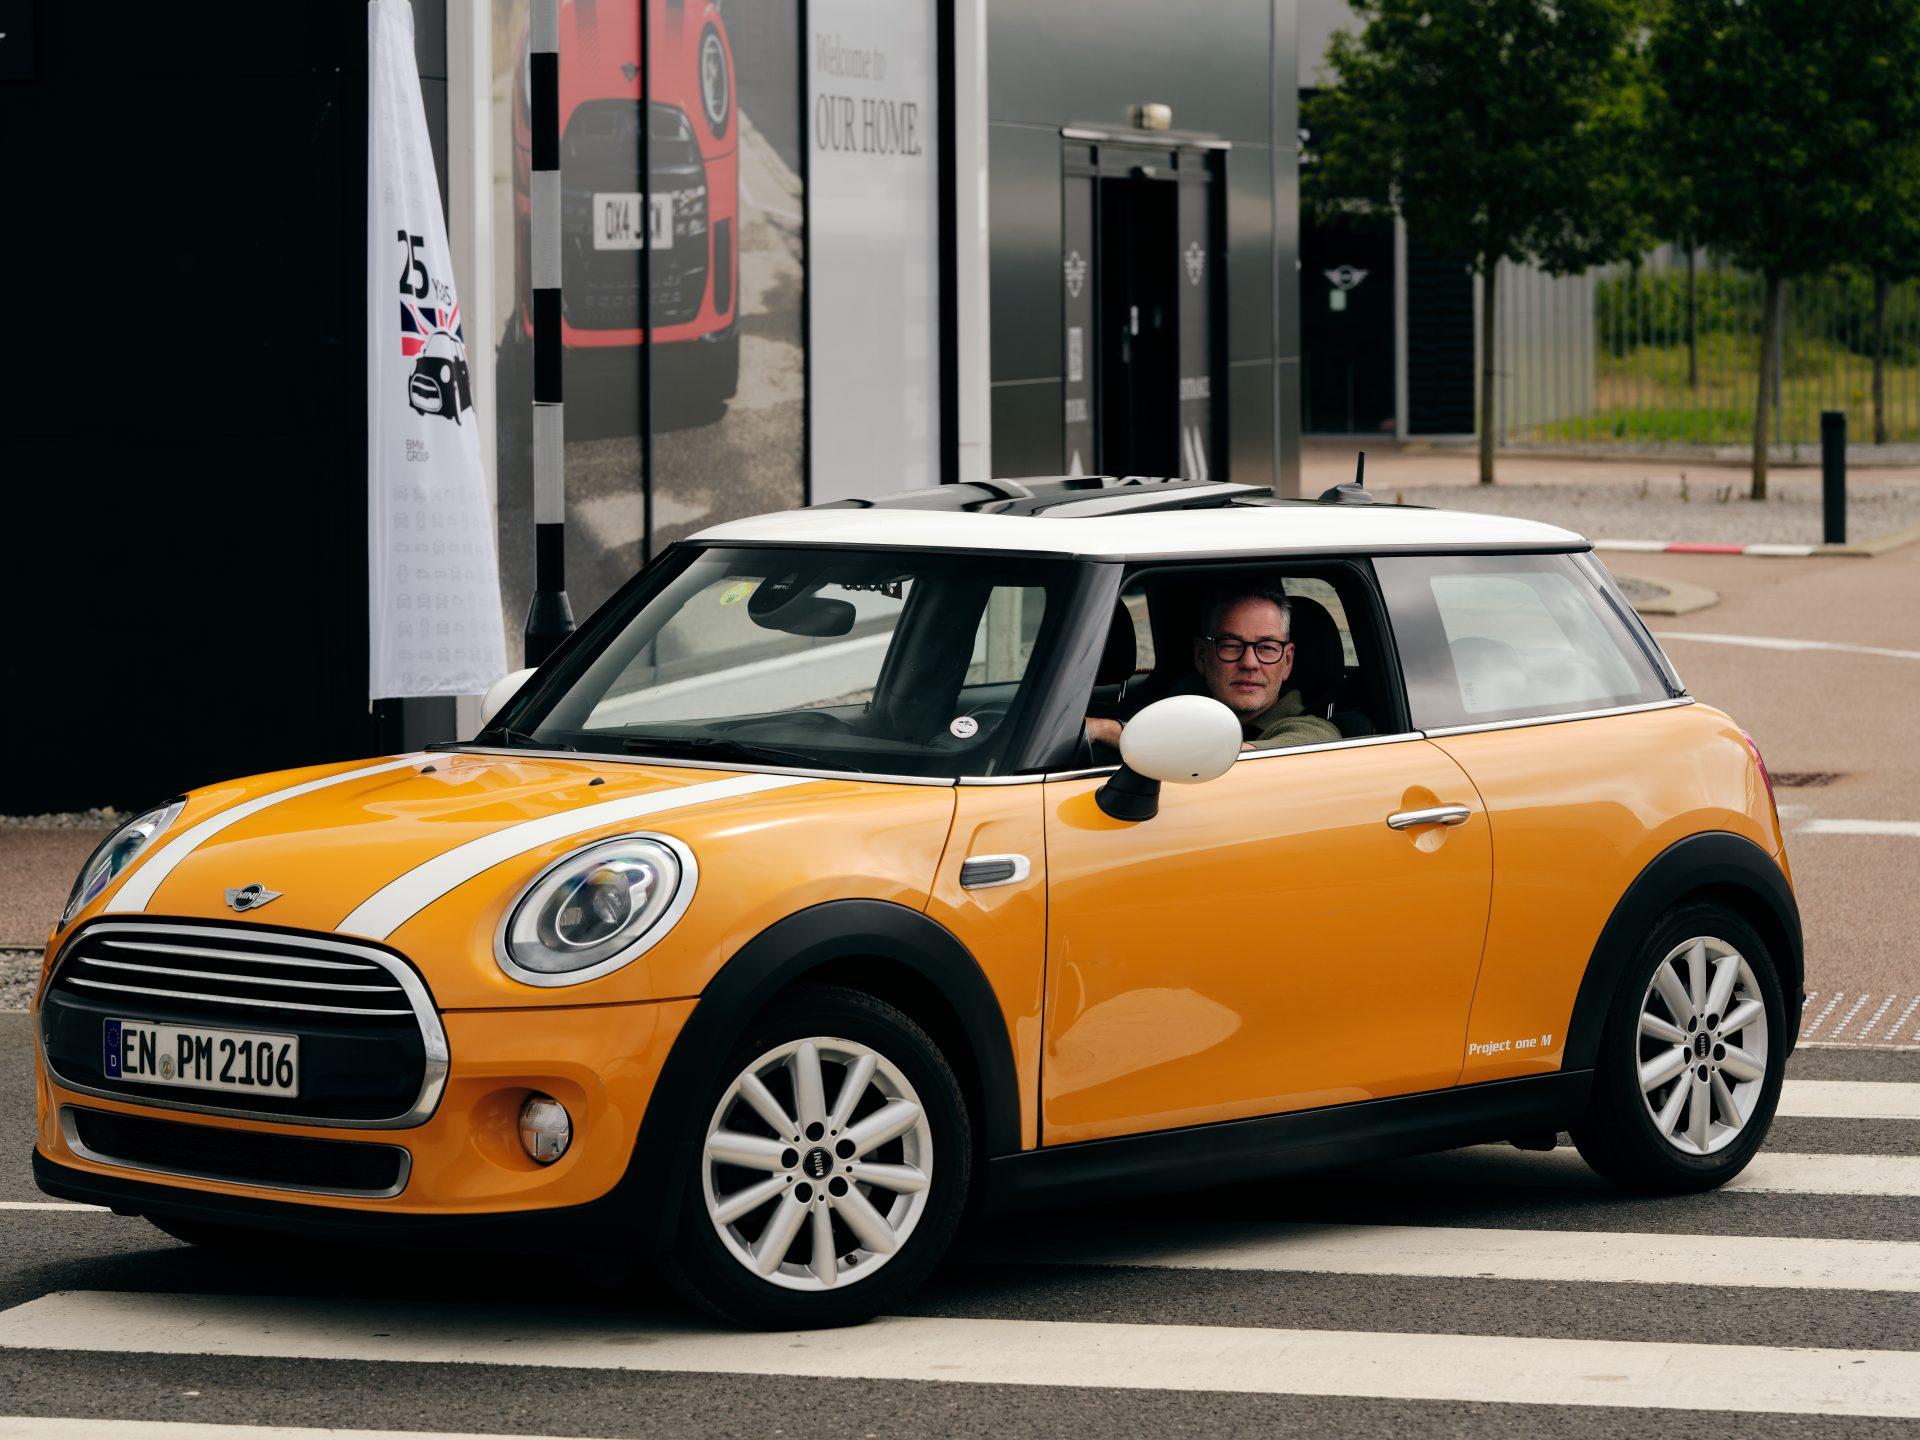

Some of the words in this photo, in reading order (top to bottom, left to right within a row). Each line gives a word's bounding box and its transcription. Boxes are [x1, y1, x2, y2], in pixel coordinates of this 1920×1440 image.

[816, 34, 870, 79] Welcome
[873, 49, 886, 81] to
[816, 94, 856, 153] OUR
[862, 98, 922, 157] HOME.
[397, 229, 429, 299] 25
[110, 1055, 117, 1067] D
[122, 1029, 156, 1075] EN
[177, 1034, 213, 1081] PM
[219, 1038, 293, 1088] 2106
[1469, 1039, 1511, 1056] Project
[1515, 1038, 1537, 1049] one
[1541, 1034, 1552, 1047] M
[813, 1151, 824, 1177] MINI
